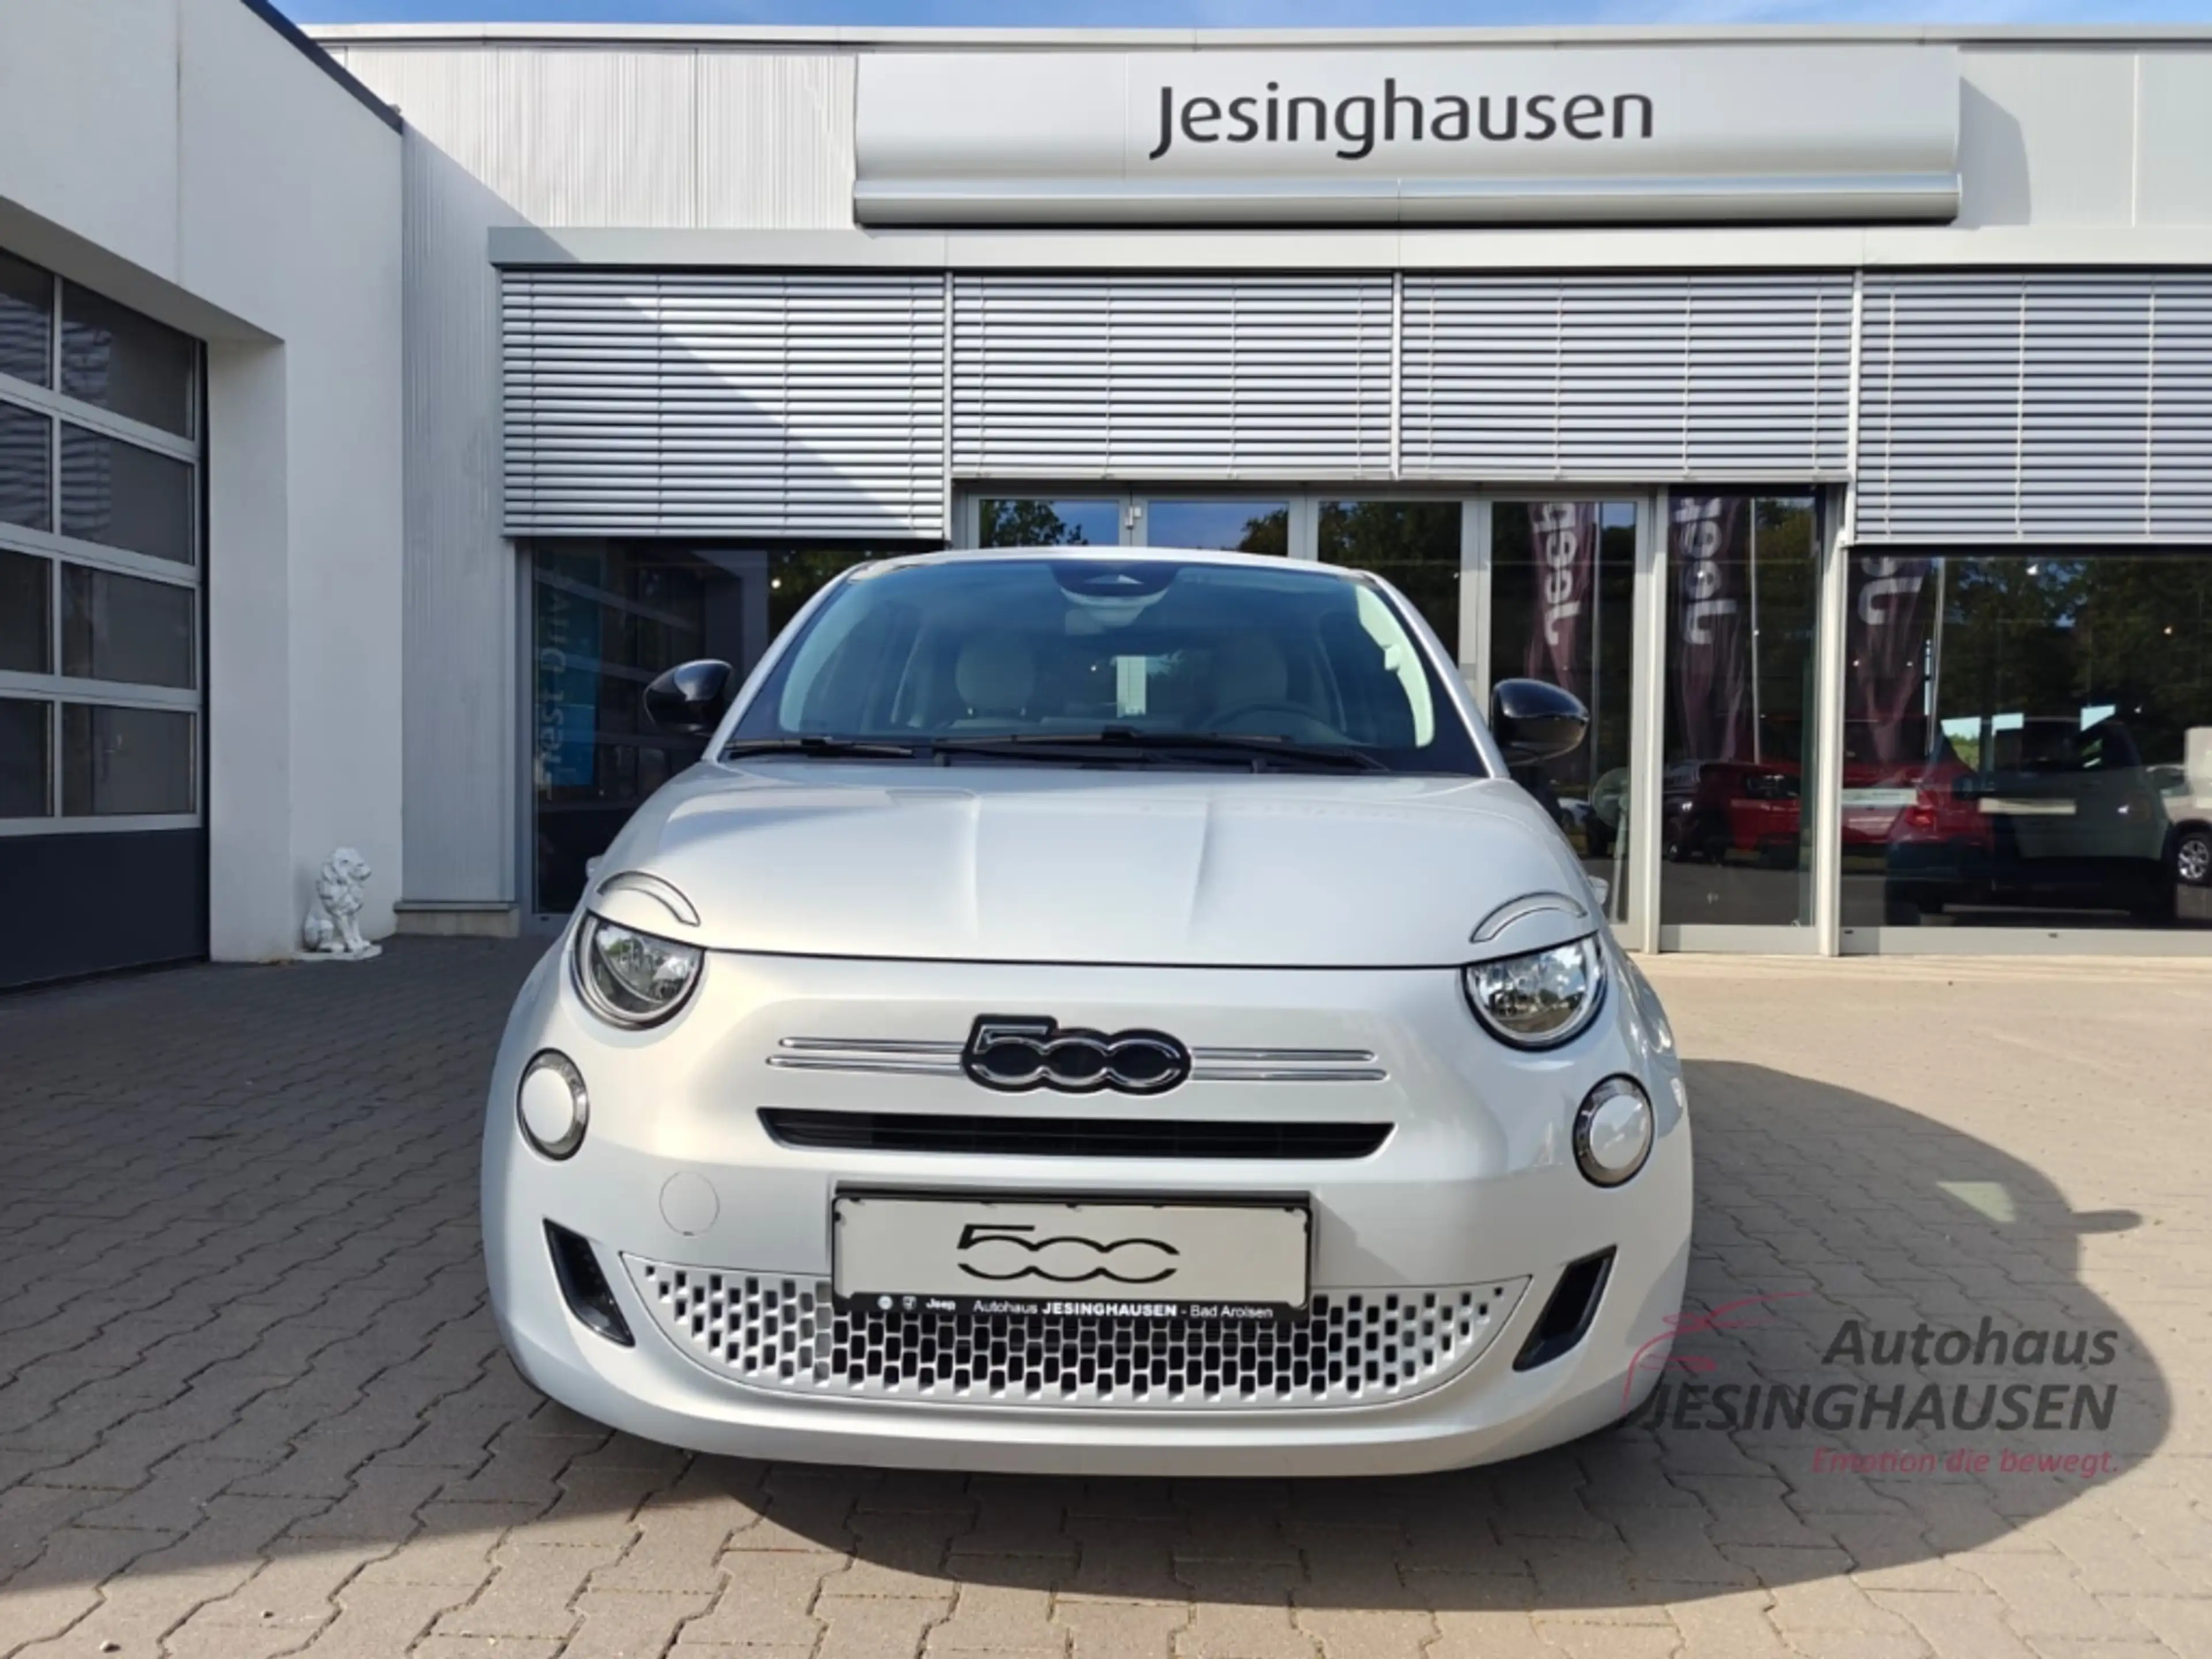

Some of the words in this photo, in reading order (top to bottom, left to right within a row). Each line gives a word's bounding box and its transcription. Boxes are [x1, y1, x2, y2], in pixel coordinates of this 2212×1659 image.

[1149, 78, 1654, 160] Jesinghausen
[969, 1017, 1187, 1092] 500
[956, 1224, 1181, 1284] 500
[973, 1299, 1037, 1314] Autohaus
[1041, 1302, 1176, 1317] JESINGHAUSEN
[1190, 1304, 1217, 1318] Bad
